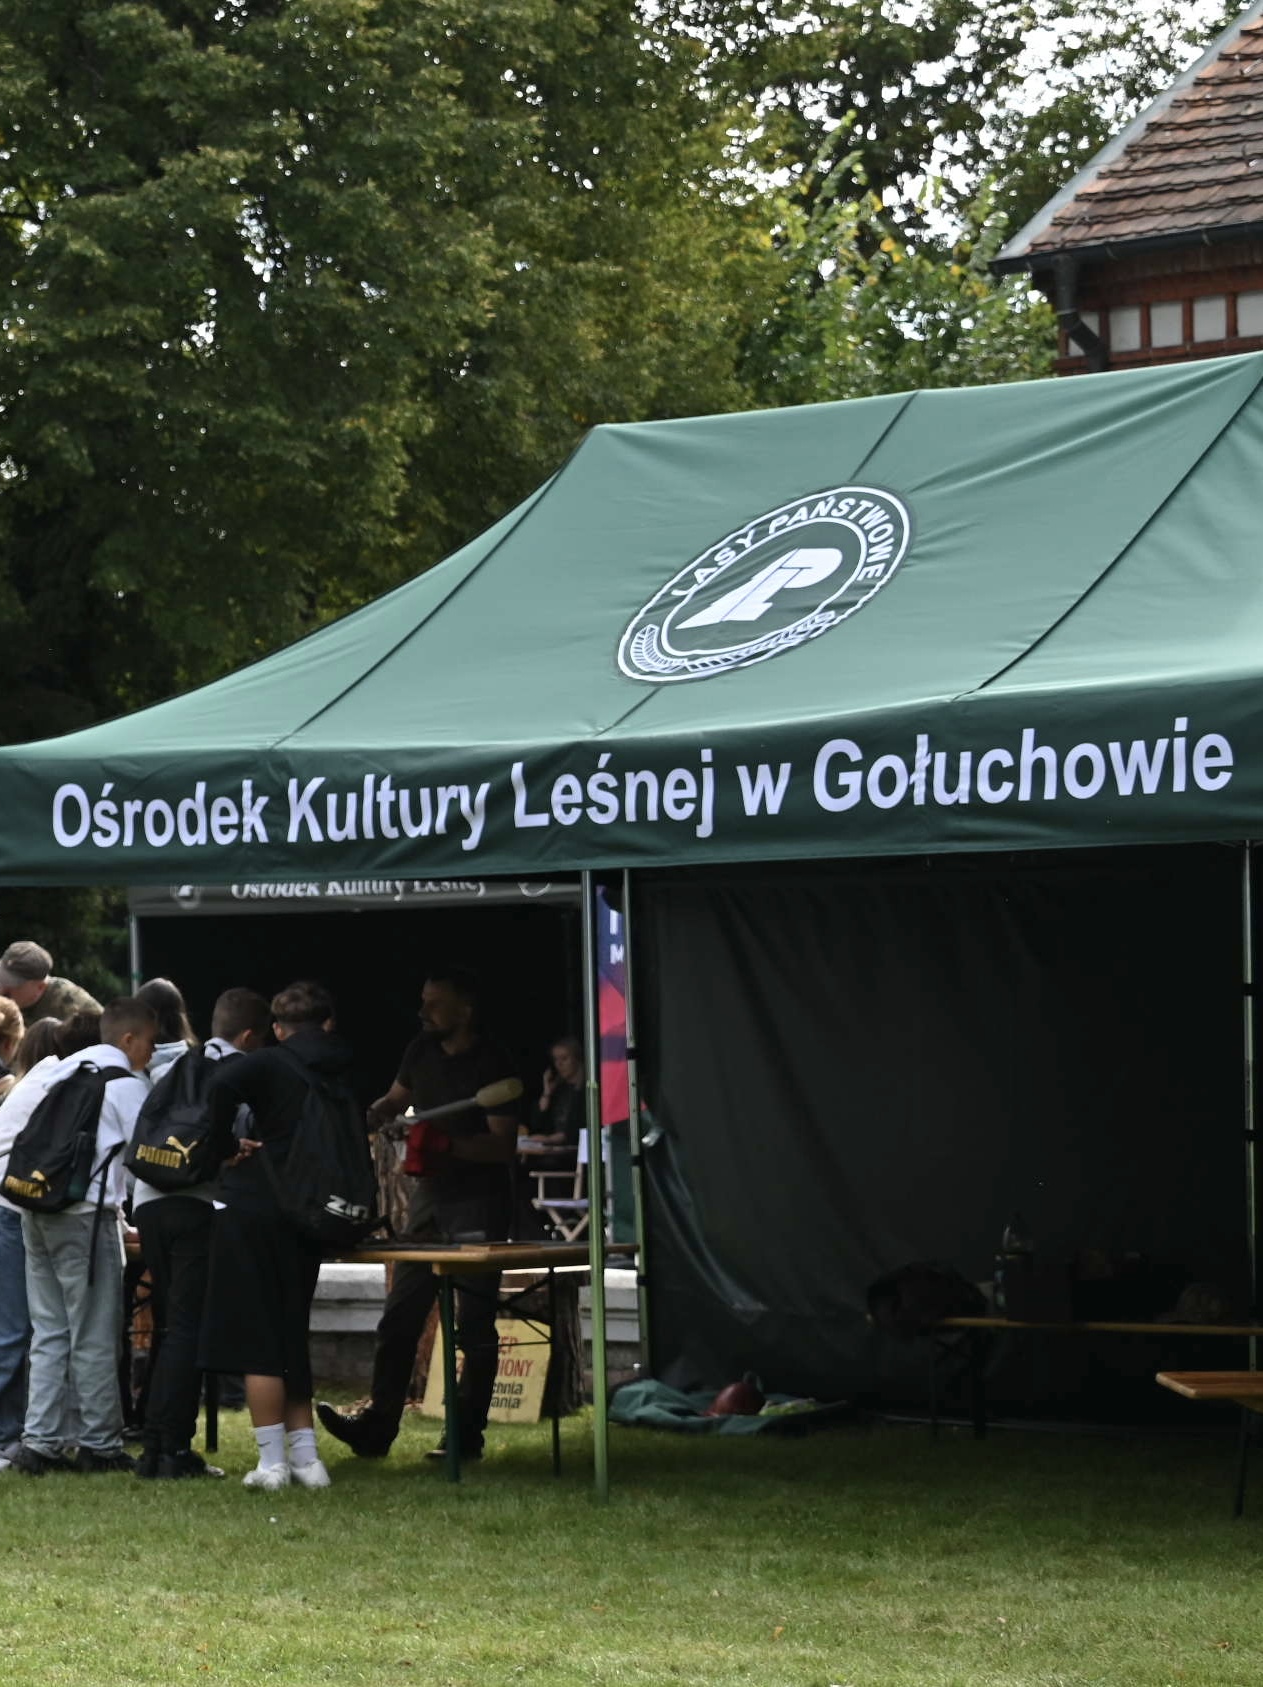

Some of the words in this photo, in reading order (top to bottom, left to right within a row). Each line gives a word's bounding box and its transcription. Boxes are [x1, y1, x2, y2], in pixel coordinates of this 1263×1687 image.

[671, 529, 755, 596] LASY
[768, 496, 896, 581] PAŃSTWOWE
[52, 779, 269, 848] Ośrodek
[287, 774, 490, 850] Kultury
[512, 749, 714, 838] Leśnej
[737, 763, 791, 816] w
[814, 717, 1234, 812] Gołuchowie
[136, 1143, 182, 1168] PUMA
